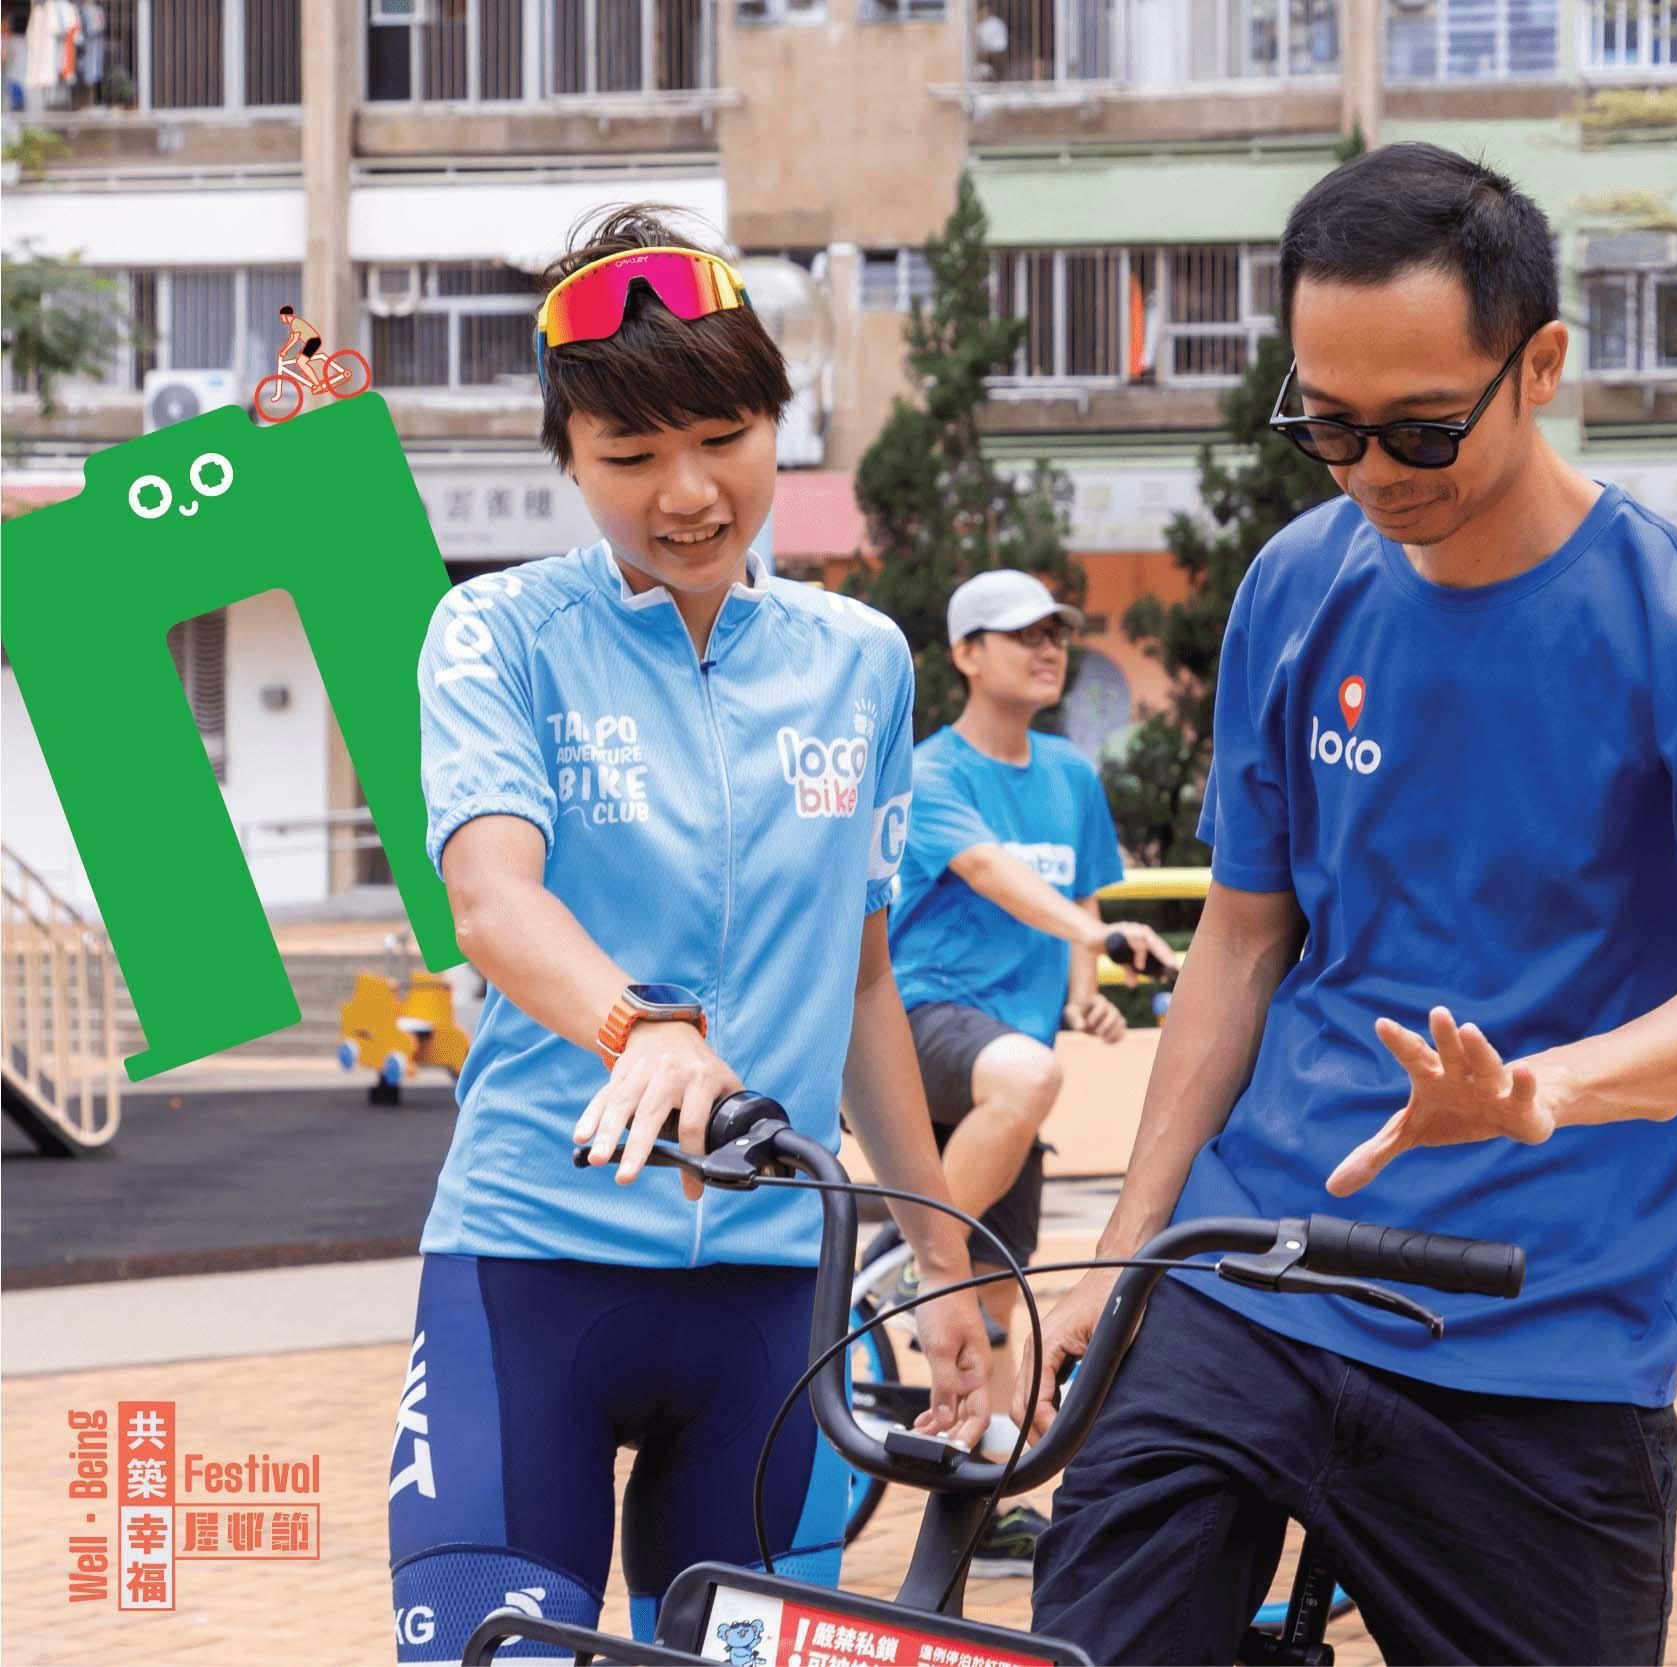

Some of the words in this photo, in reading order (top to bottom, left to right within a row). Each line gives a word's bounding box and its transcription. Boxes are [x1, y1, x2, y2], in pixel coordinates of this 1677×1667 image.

[595, 715, 638, 748] PO
[1310, 715, 1382, 775] loco
[556, 744, 642, 764] ADVENTURE
[779, 728, 868, 783] loco
[559, 765, 649, 802] BIKE
[797, 778, 858, 817] bike
[593, 802, 650, 824] CLUB
